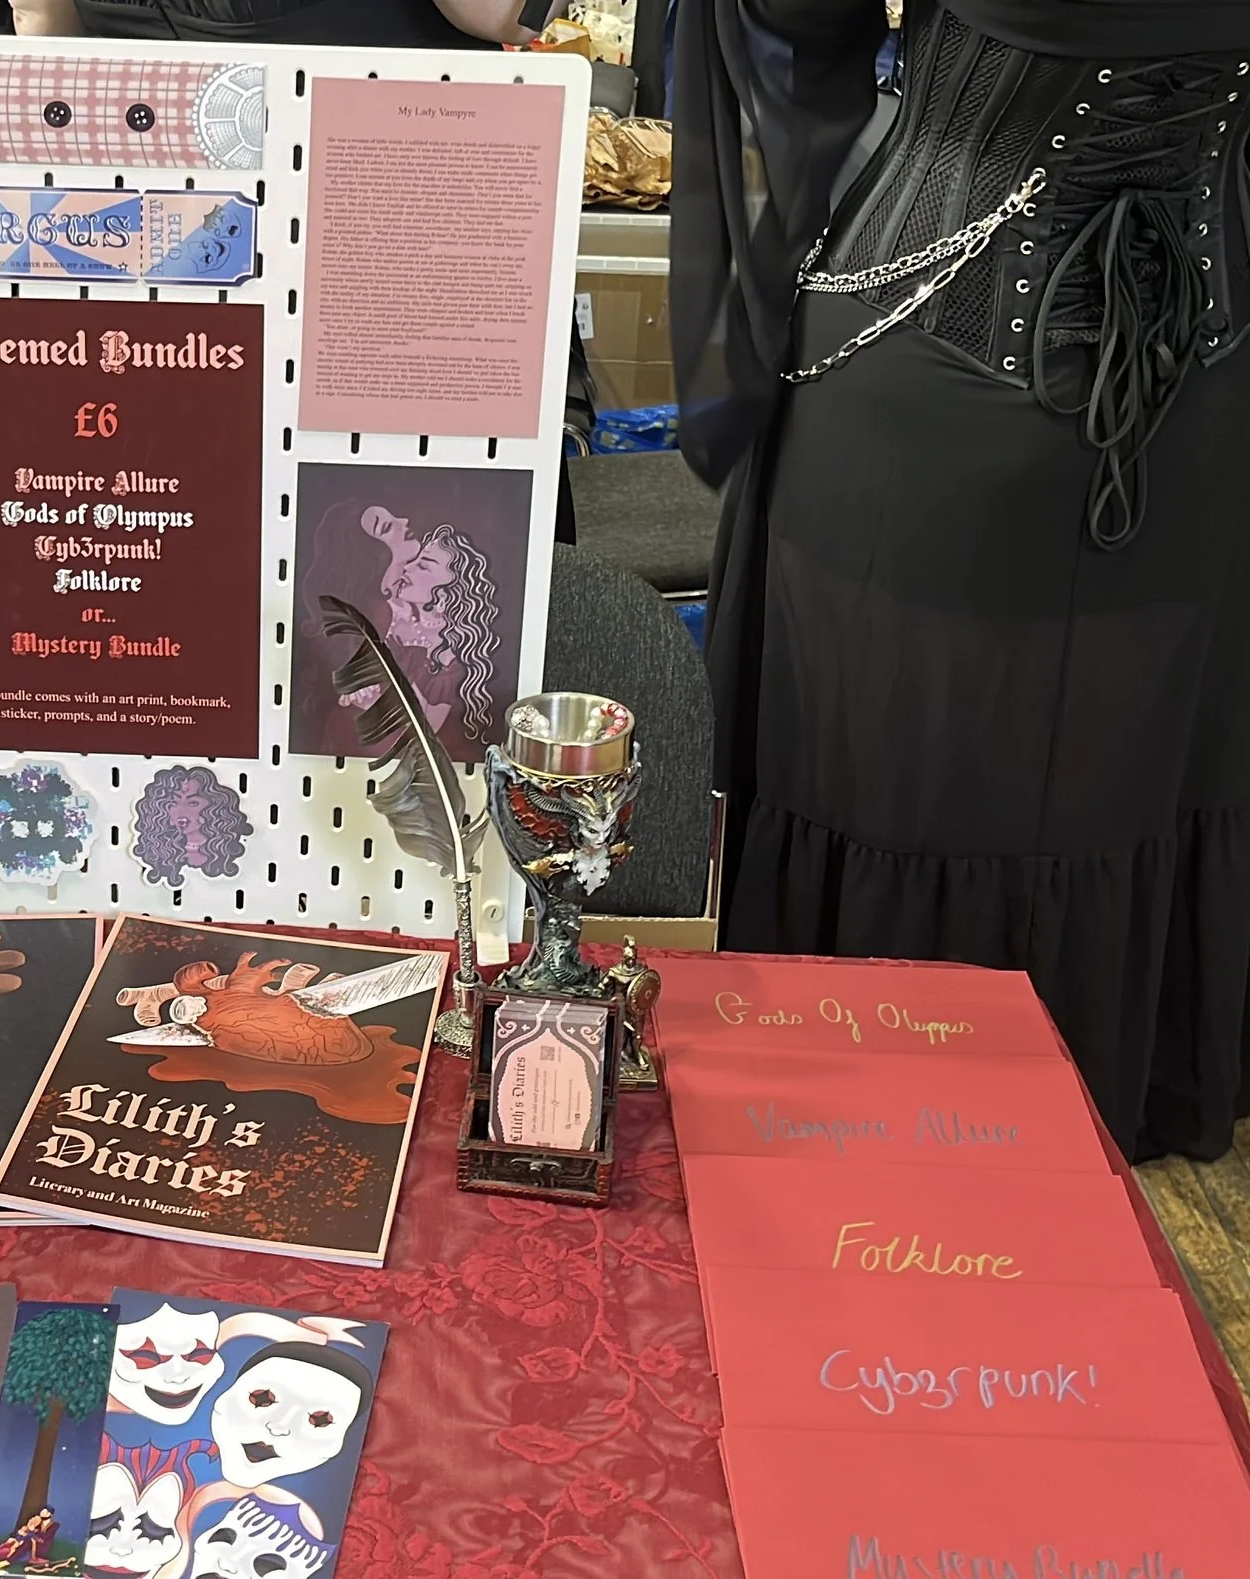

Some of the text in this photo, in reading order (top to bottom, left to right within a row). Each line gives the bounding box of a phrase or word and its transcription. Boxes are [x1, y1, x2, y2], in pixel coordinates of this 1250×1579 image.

[398, 106, 477, 120] My Lady Vampyre
[149, 199, 164, 275] ADMIT
[99, 330, 245, 375] Bundles
[74, 402, 118, 438] £6
[14, 467, 180, 497] Vampire Allure
[0, 500, 194, 533] Gods of Olympus
[35, 535, 162, 565] Cyb3rpunk!
[52, 568, 142, 595] Folklore
[81, 608, 116, 624] or...
[11, 632, 182, 660] Mystery Bundle
[34, 693, 71, 703] comes
[74, 691, 100, 704] with
[102, 695, 117, 705] an
[118, 694, 134, 705] art
[137, 694, 168, 709] print,
[170, 694, 231, 709] bookmark,
[44, 709, 94, 724] prompts,
[96, 710, 117, 722] and
[120, 714, 127, 723] a
[129, 711, 196, 726] story/poem.
[56, 1083, 266, 1149] Lilith's
[509, 1056, 527, 1142] Lilith's Diaries
[746, 1101, 1023, 1157] Vampire Allure
[35, 1124, 251, 1198] Diaries
[29, 1175, 210, 1219] Literary and Art Magazine
[832, 1221, 1023, 1280] Folklore
